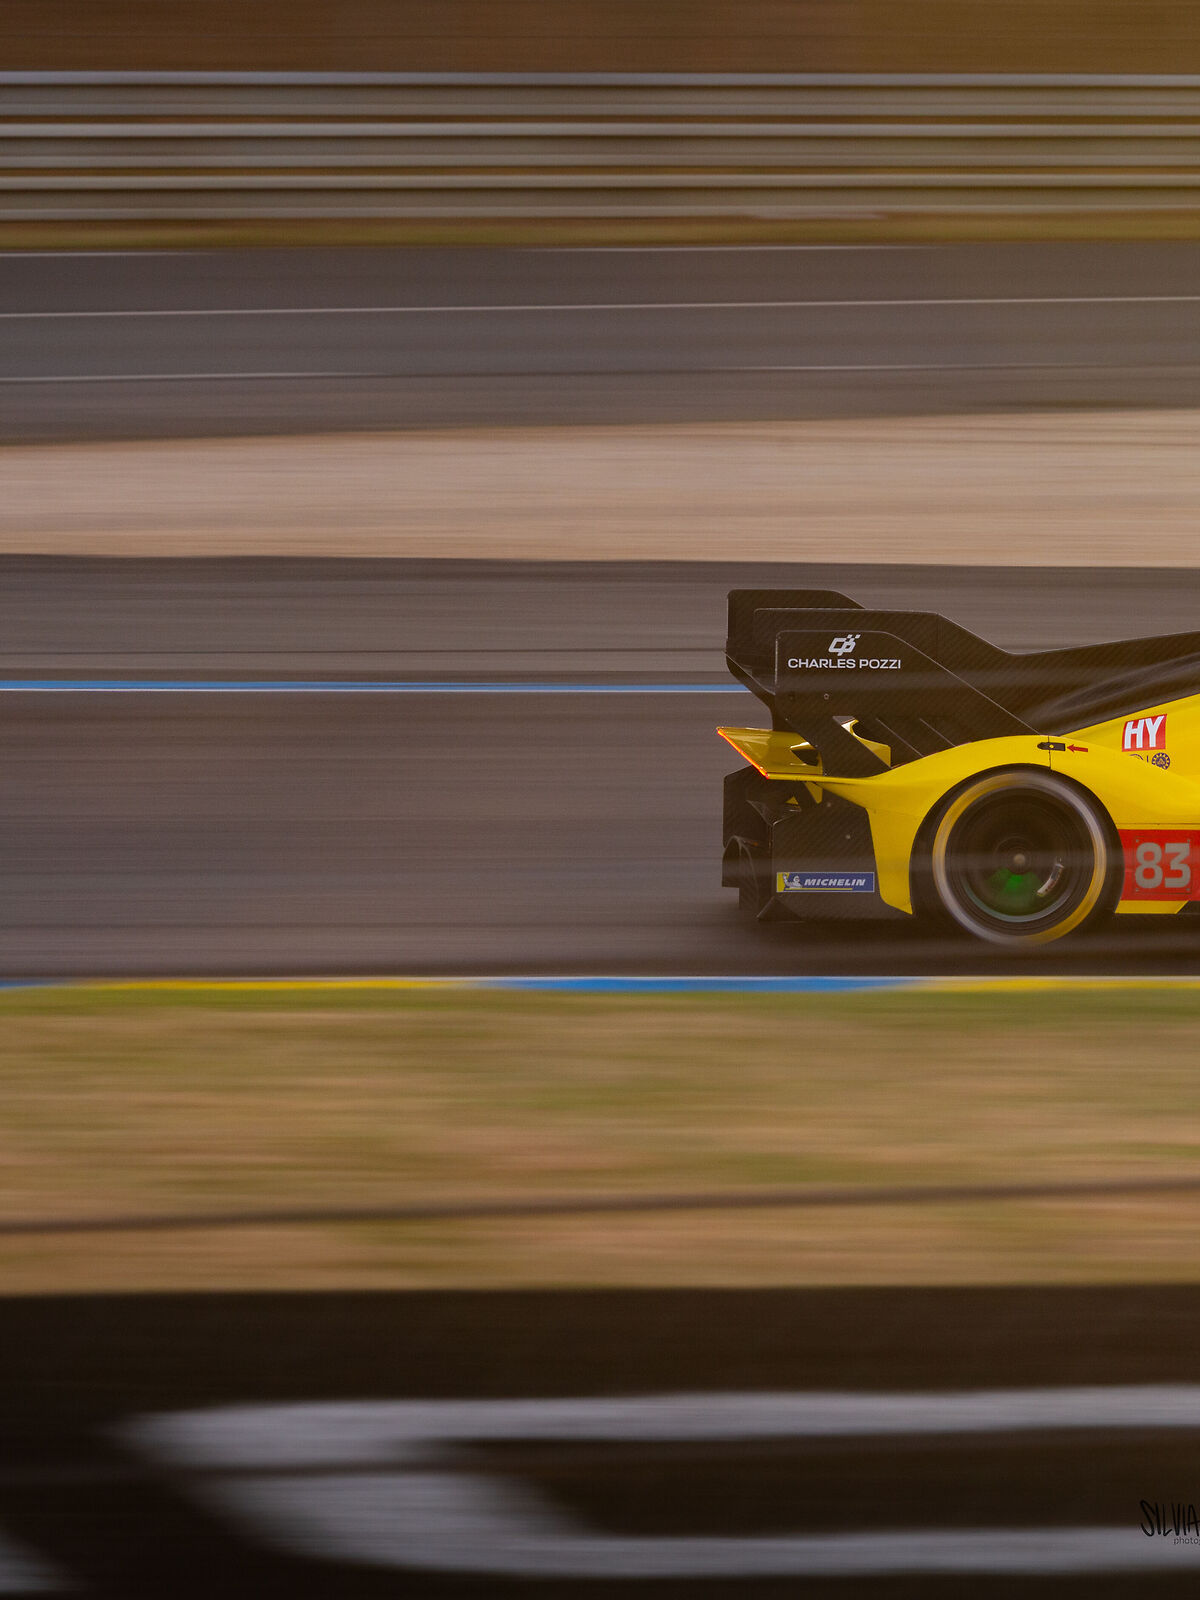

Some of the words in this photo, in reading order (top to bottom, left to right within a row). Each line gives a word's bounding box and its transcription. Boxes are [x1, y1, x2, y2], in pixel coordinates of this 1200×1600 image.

[787, 658, 856, 669] CHARLES
[859, 659, 901, 669] POZZI
[1124, 715, 1165, 750] HY
[1135, 842, 1191, 889] 83
[804, 878, 866, 886] MICHELIN
